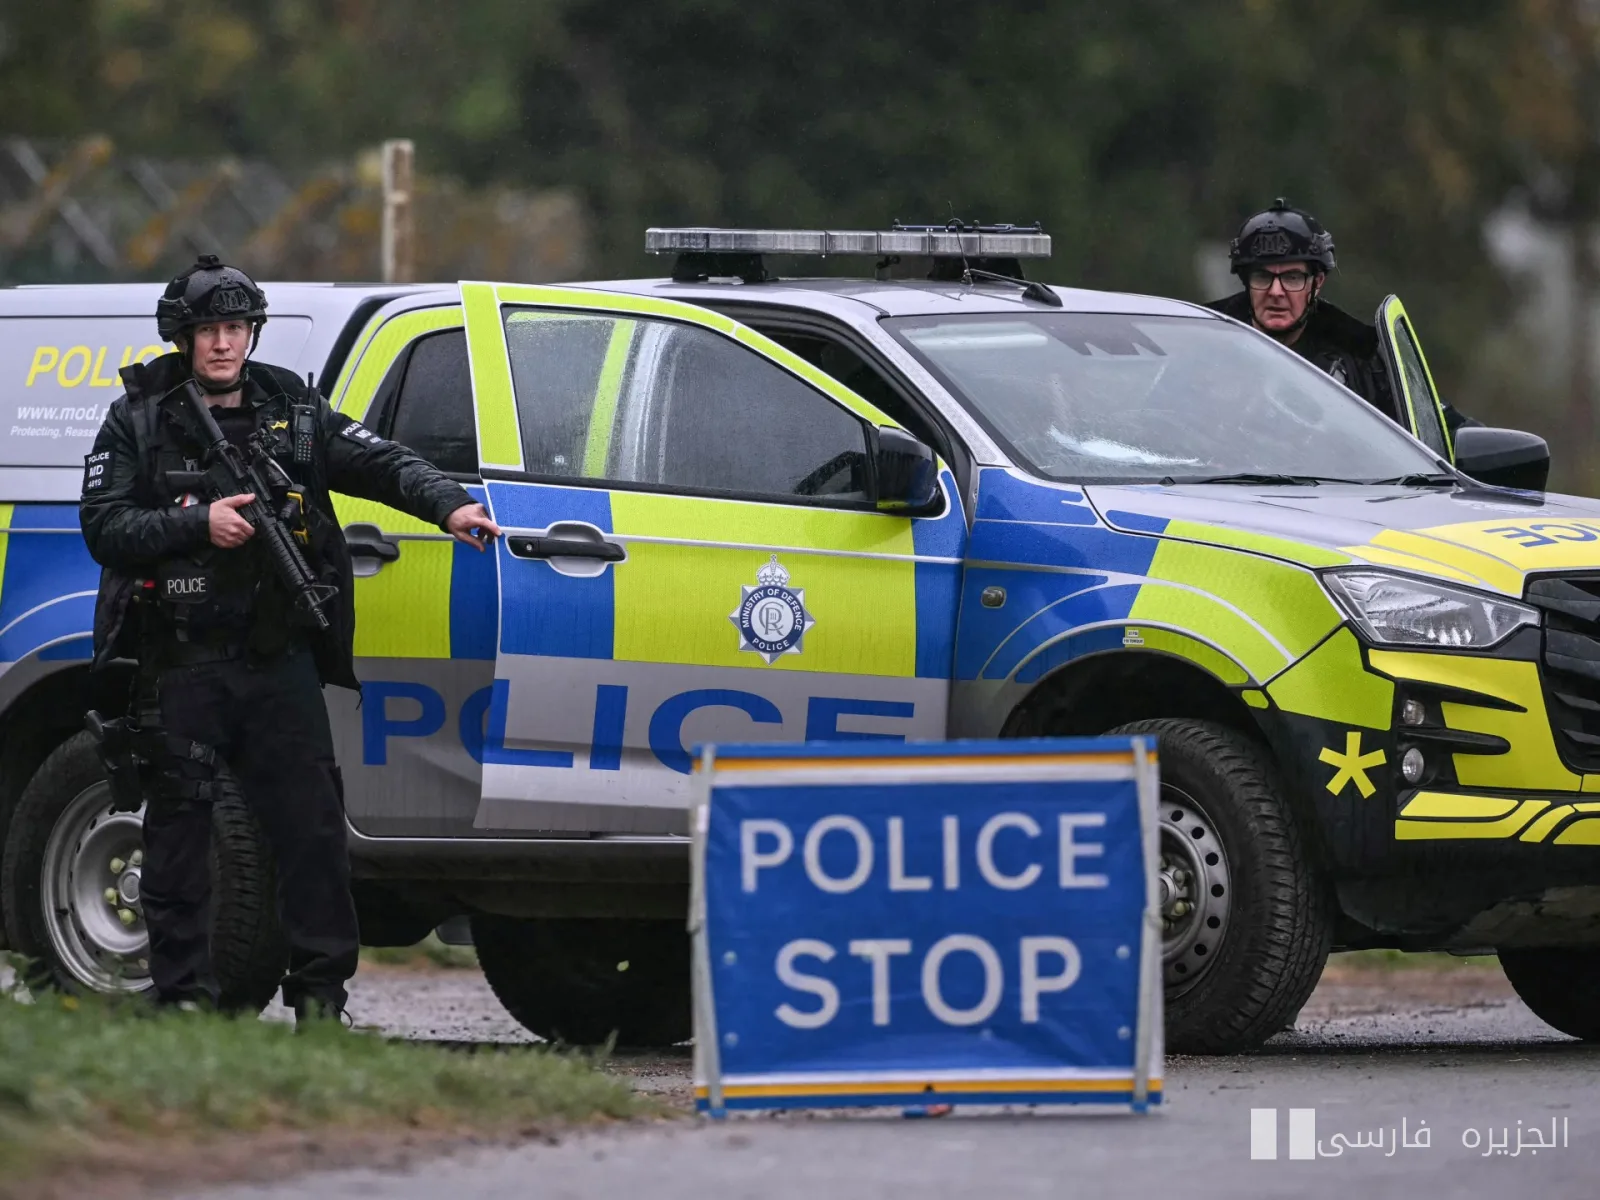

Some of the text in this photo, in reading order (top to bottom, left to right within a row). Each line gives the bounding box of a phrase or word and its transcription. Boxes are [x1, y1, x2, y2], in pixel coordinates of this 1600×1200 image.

[25, 345, 180, 388] POLI
[88, 451, 110, 464] POLICE
[88, 464, 104, 478] MD
[167, 577, 206, 594] POLICE
[742, 588, 803, 631] MINISTRY OF DEFENCE
[752, 637, 790, 651] POLICE
[740, 812, 1109, 894] POLICE
[774, 933, 1082, 1029] STOP
